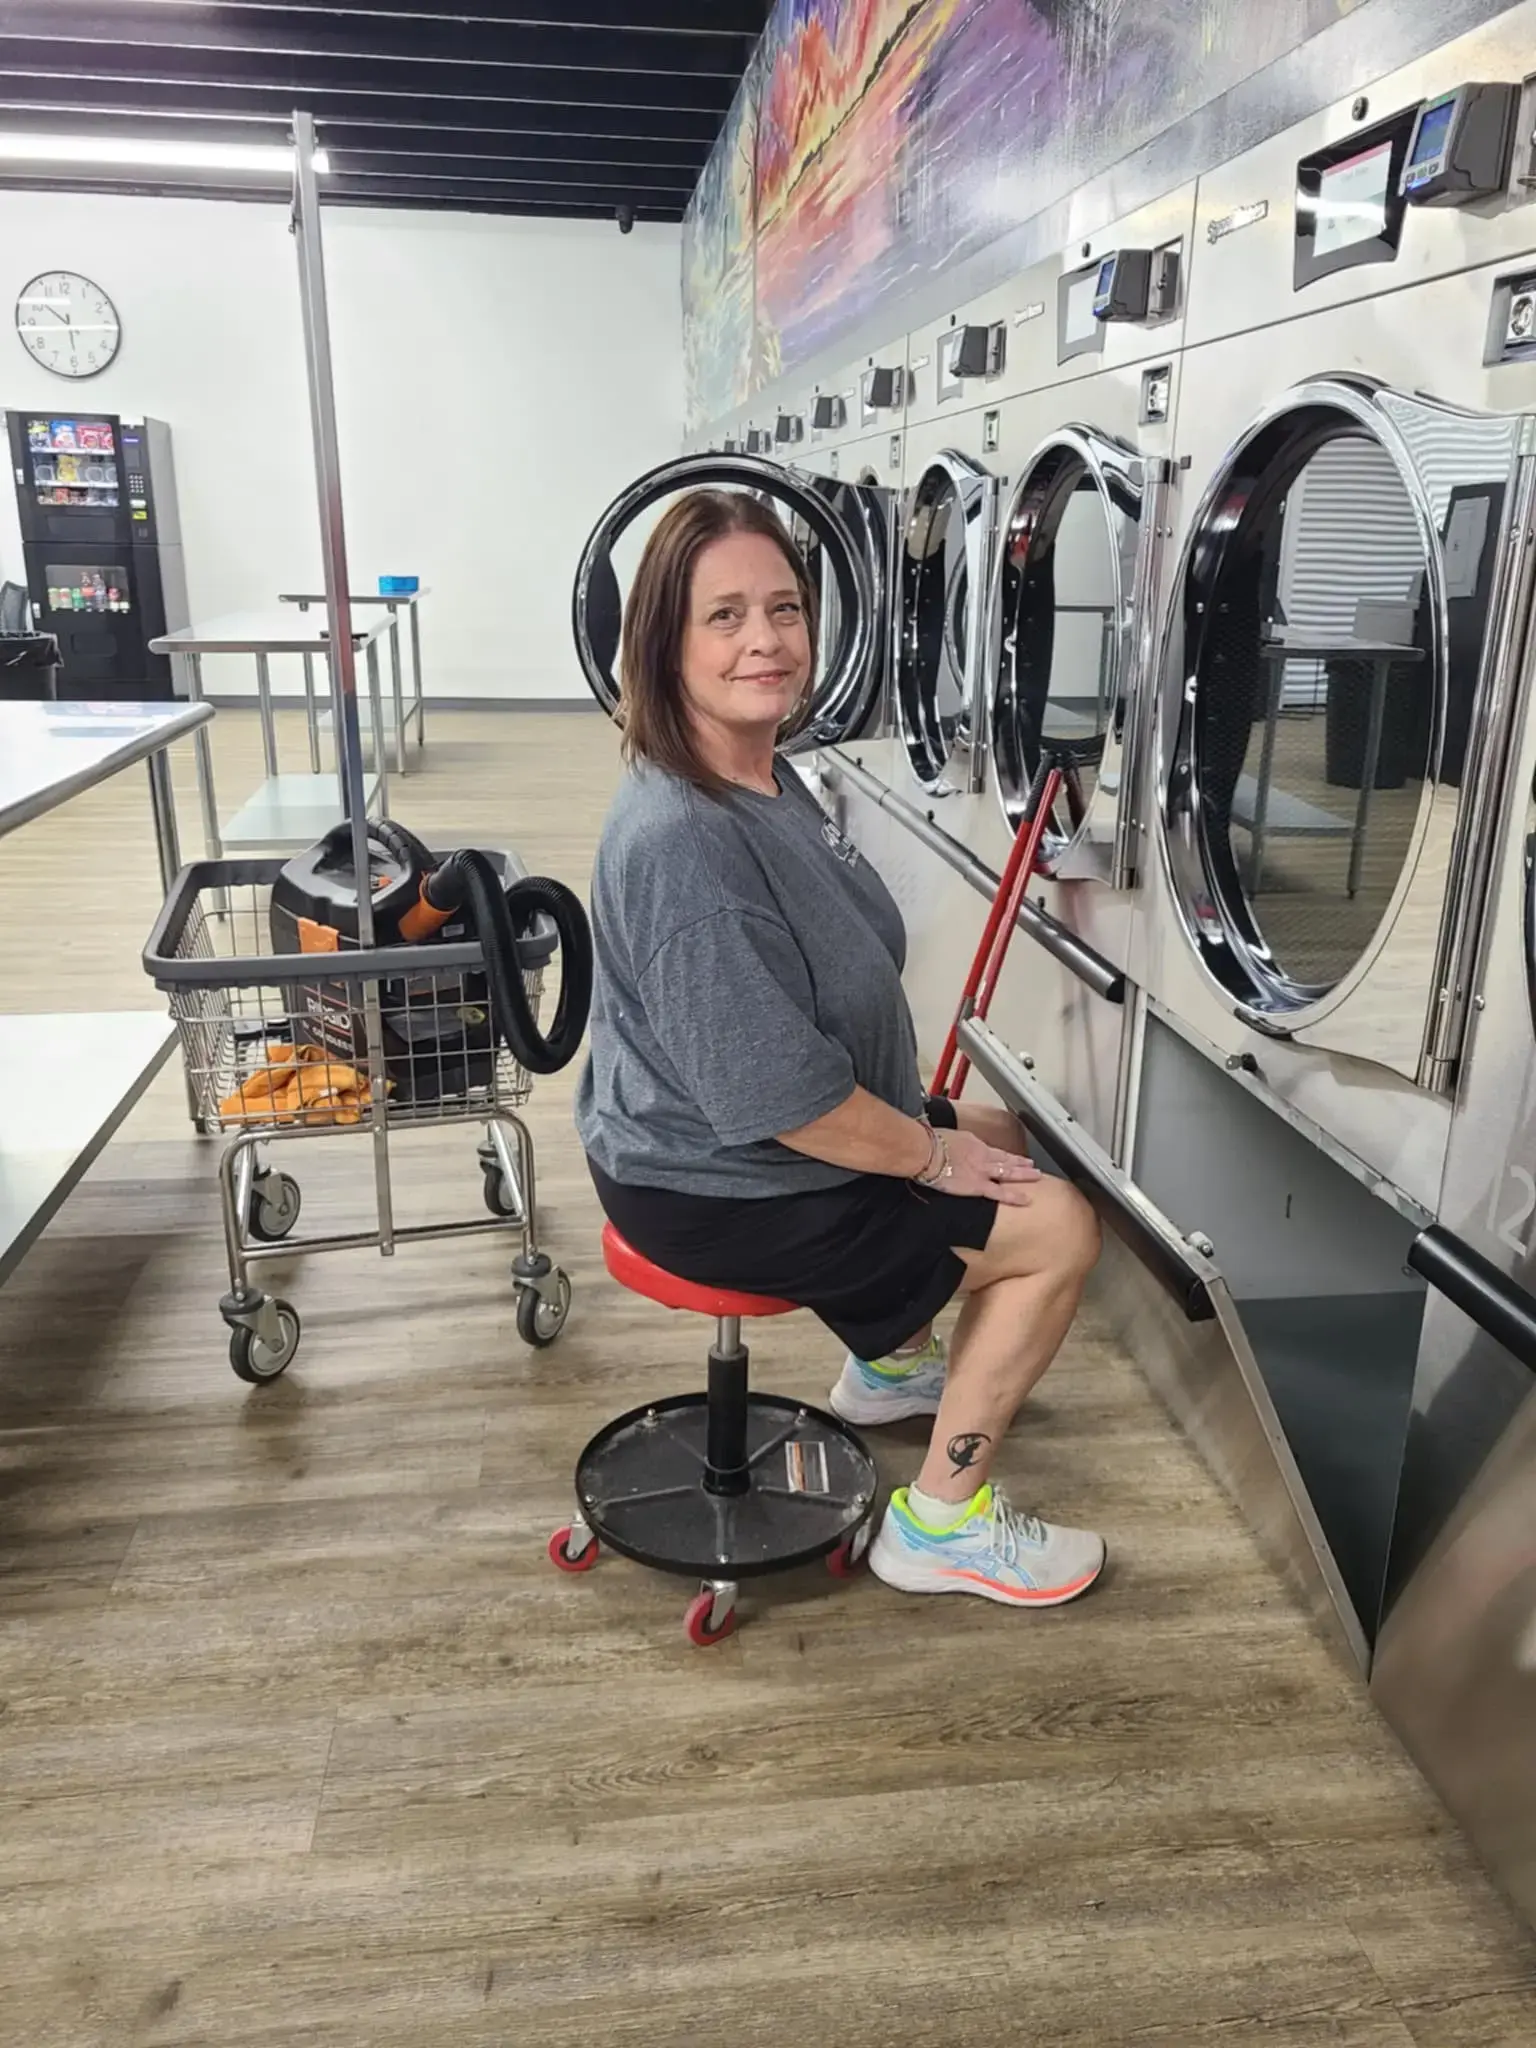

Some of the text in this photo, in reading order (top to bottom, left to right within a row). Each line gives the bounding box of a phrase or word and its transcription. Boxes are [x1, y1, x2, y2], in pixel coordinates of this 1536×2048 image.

[59, 282, 70, 295] 12
[95, 301, 102, 314] 2
[36, 336, 45, 349] 8
[52, 349, 59, 361] 7
[70, 355, 79, 368] 6
[88, 351, 96, 363] 5
